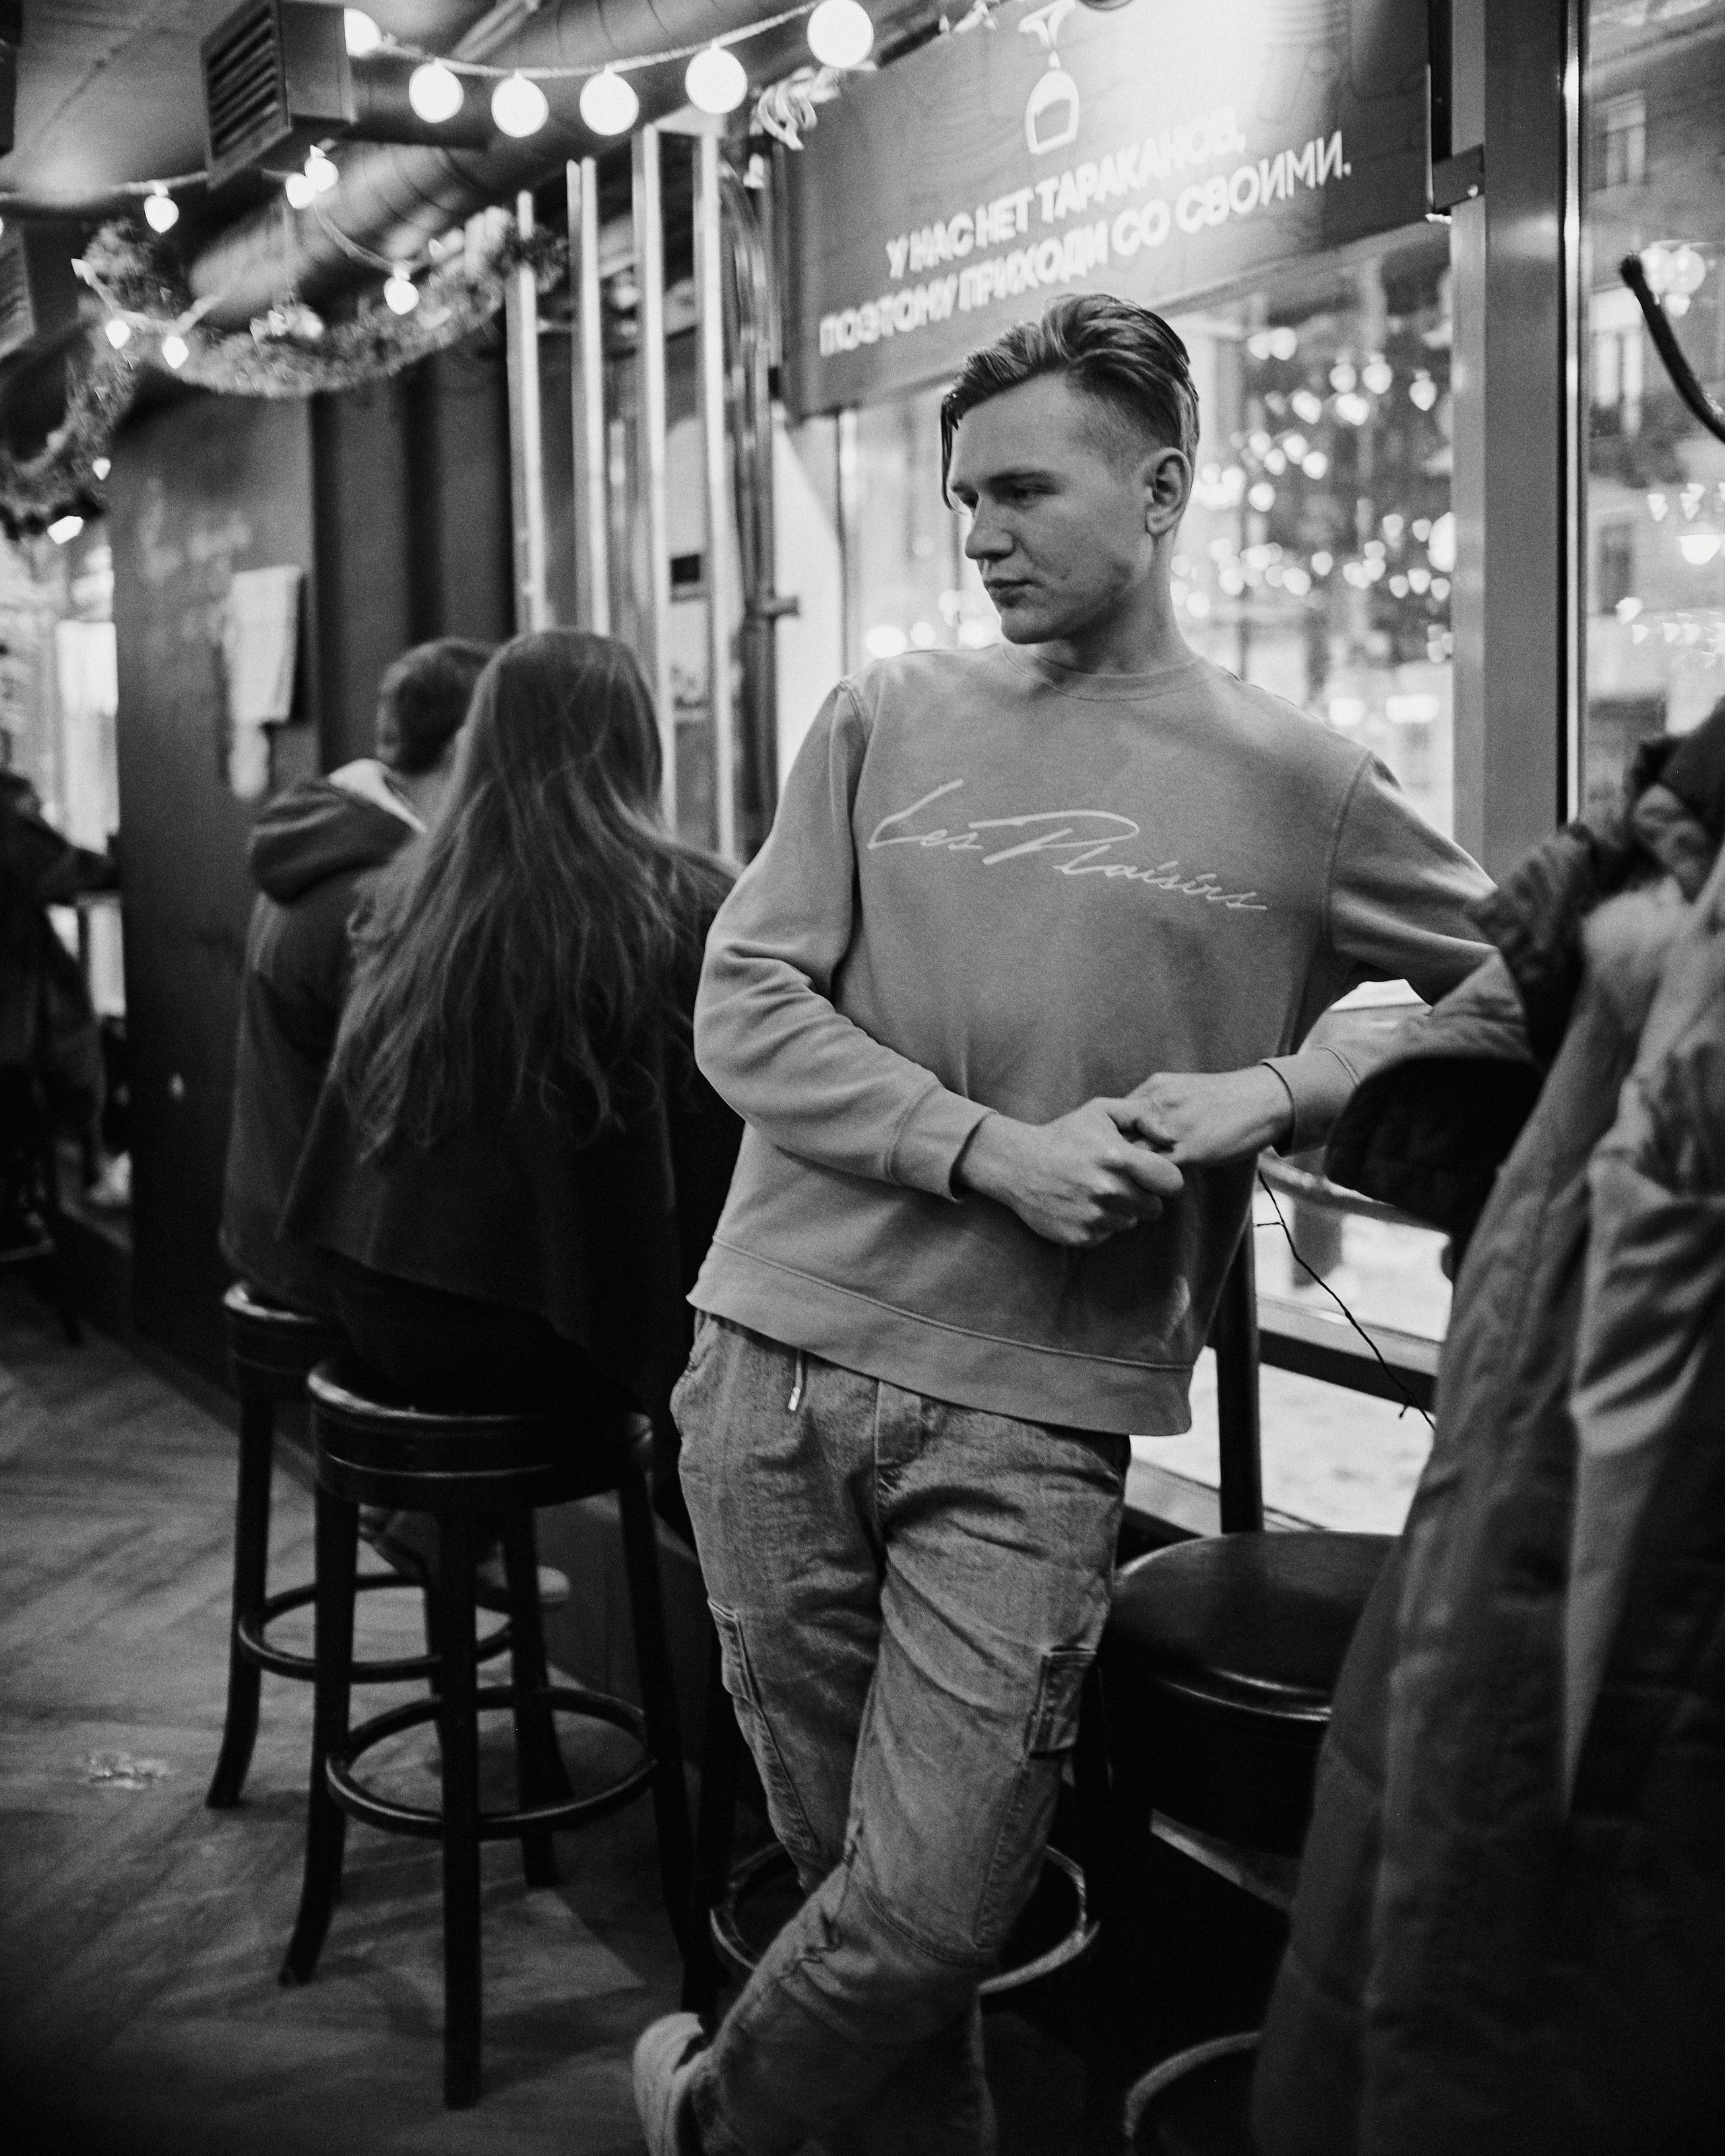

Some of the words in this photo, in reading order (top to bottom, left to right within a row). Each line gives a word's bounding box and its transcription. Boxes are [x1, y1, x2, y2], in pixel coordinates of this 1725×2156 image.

[819, 273, 958, 358] ПОЭТОМУ
[958, 218, 1109, 312] ПРИХОДИ
[1110, 197, 1171, 256] СО
[1174, 130, 1352, 233] СВОИМИ.
[885, 234, 909, 280] У
[908, 211, 975, 273] НАС
[975, 185, 1036, 249] НЕТ
[867, 778, 984, 851] Les
